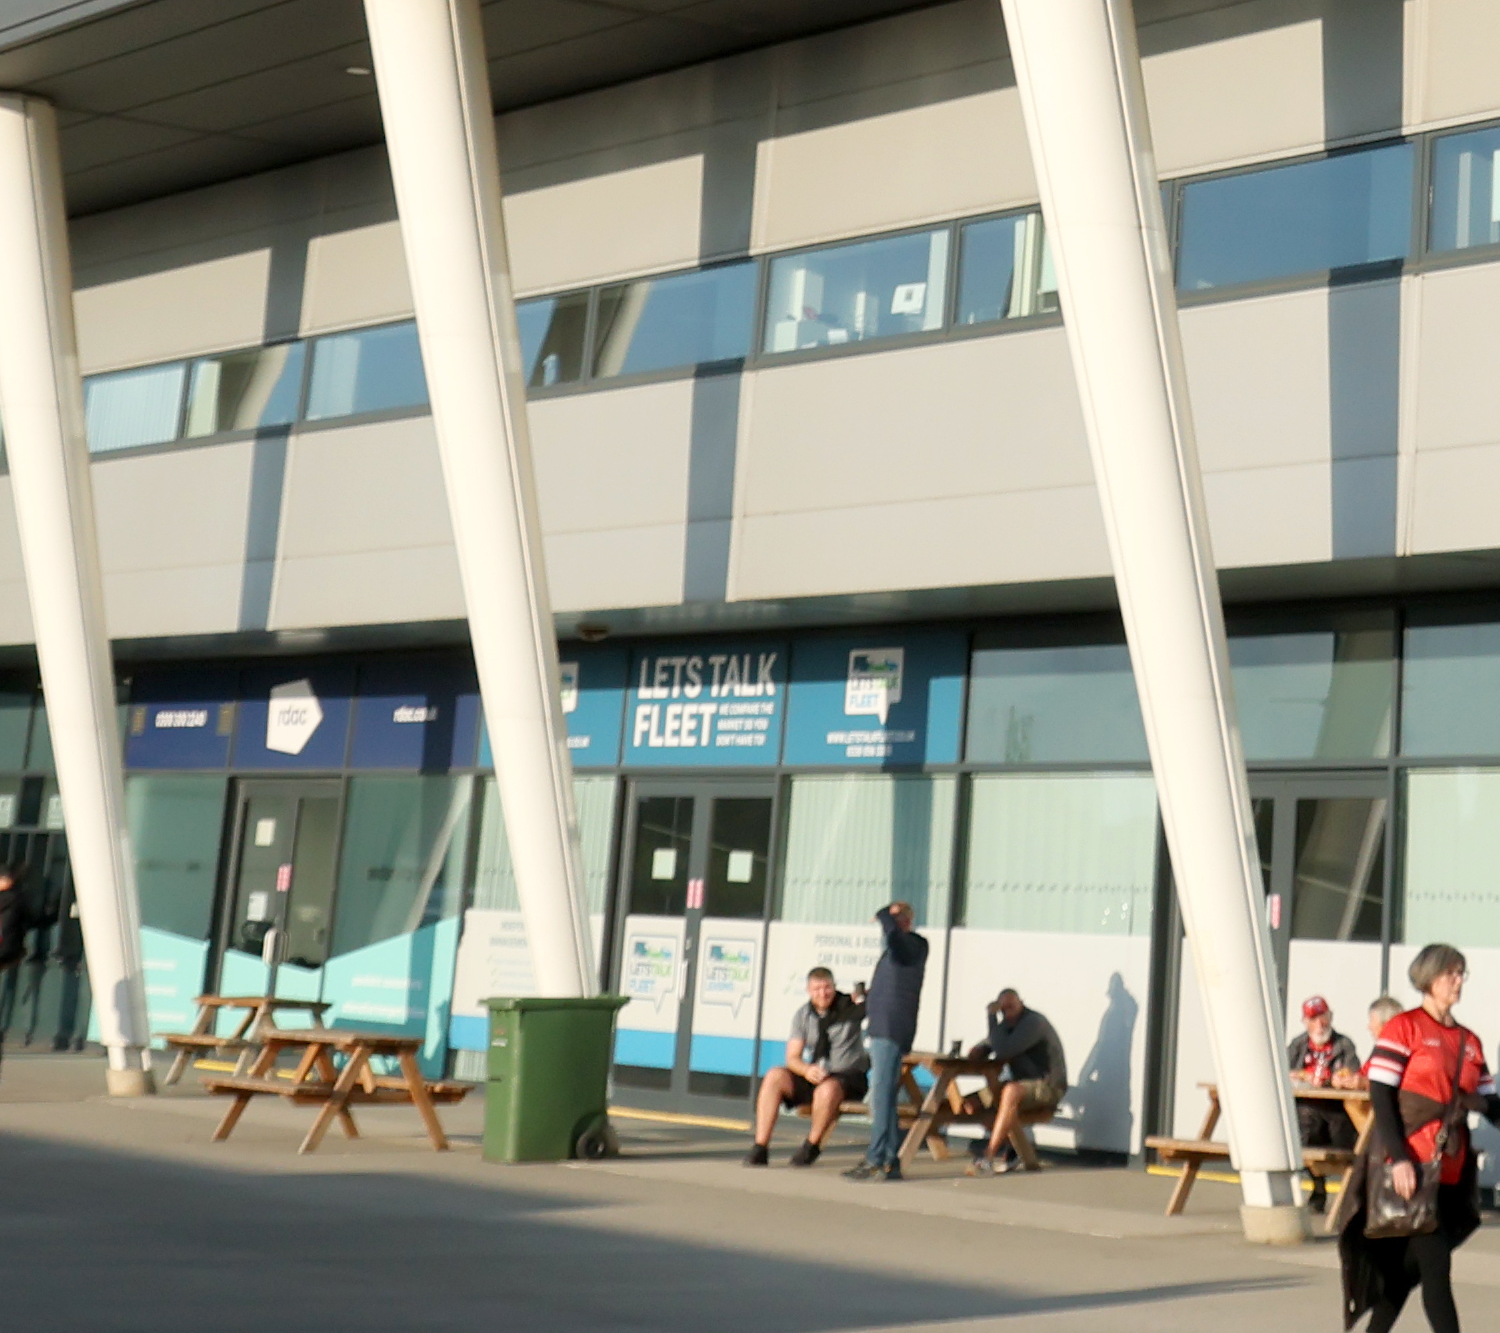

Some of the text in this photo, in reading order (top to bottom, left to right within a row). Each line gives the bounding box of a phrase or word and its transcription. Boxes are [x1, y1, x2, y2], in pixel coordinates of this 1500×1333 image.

[637, 651, 778, 700] LETS TALK
[632, 702, 719, 748] FLEET
